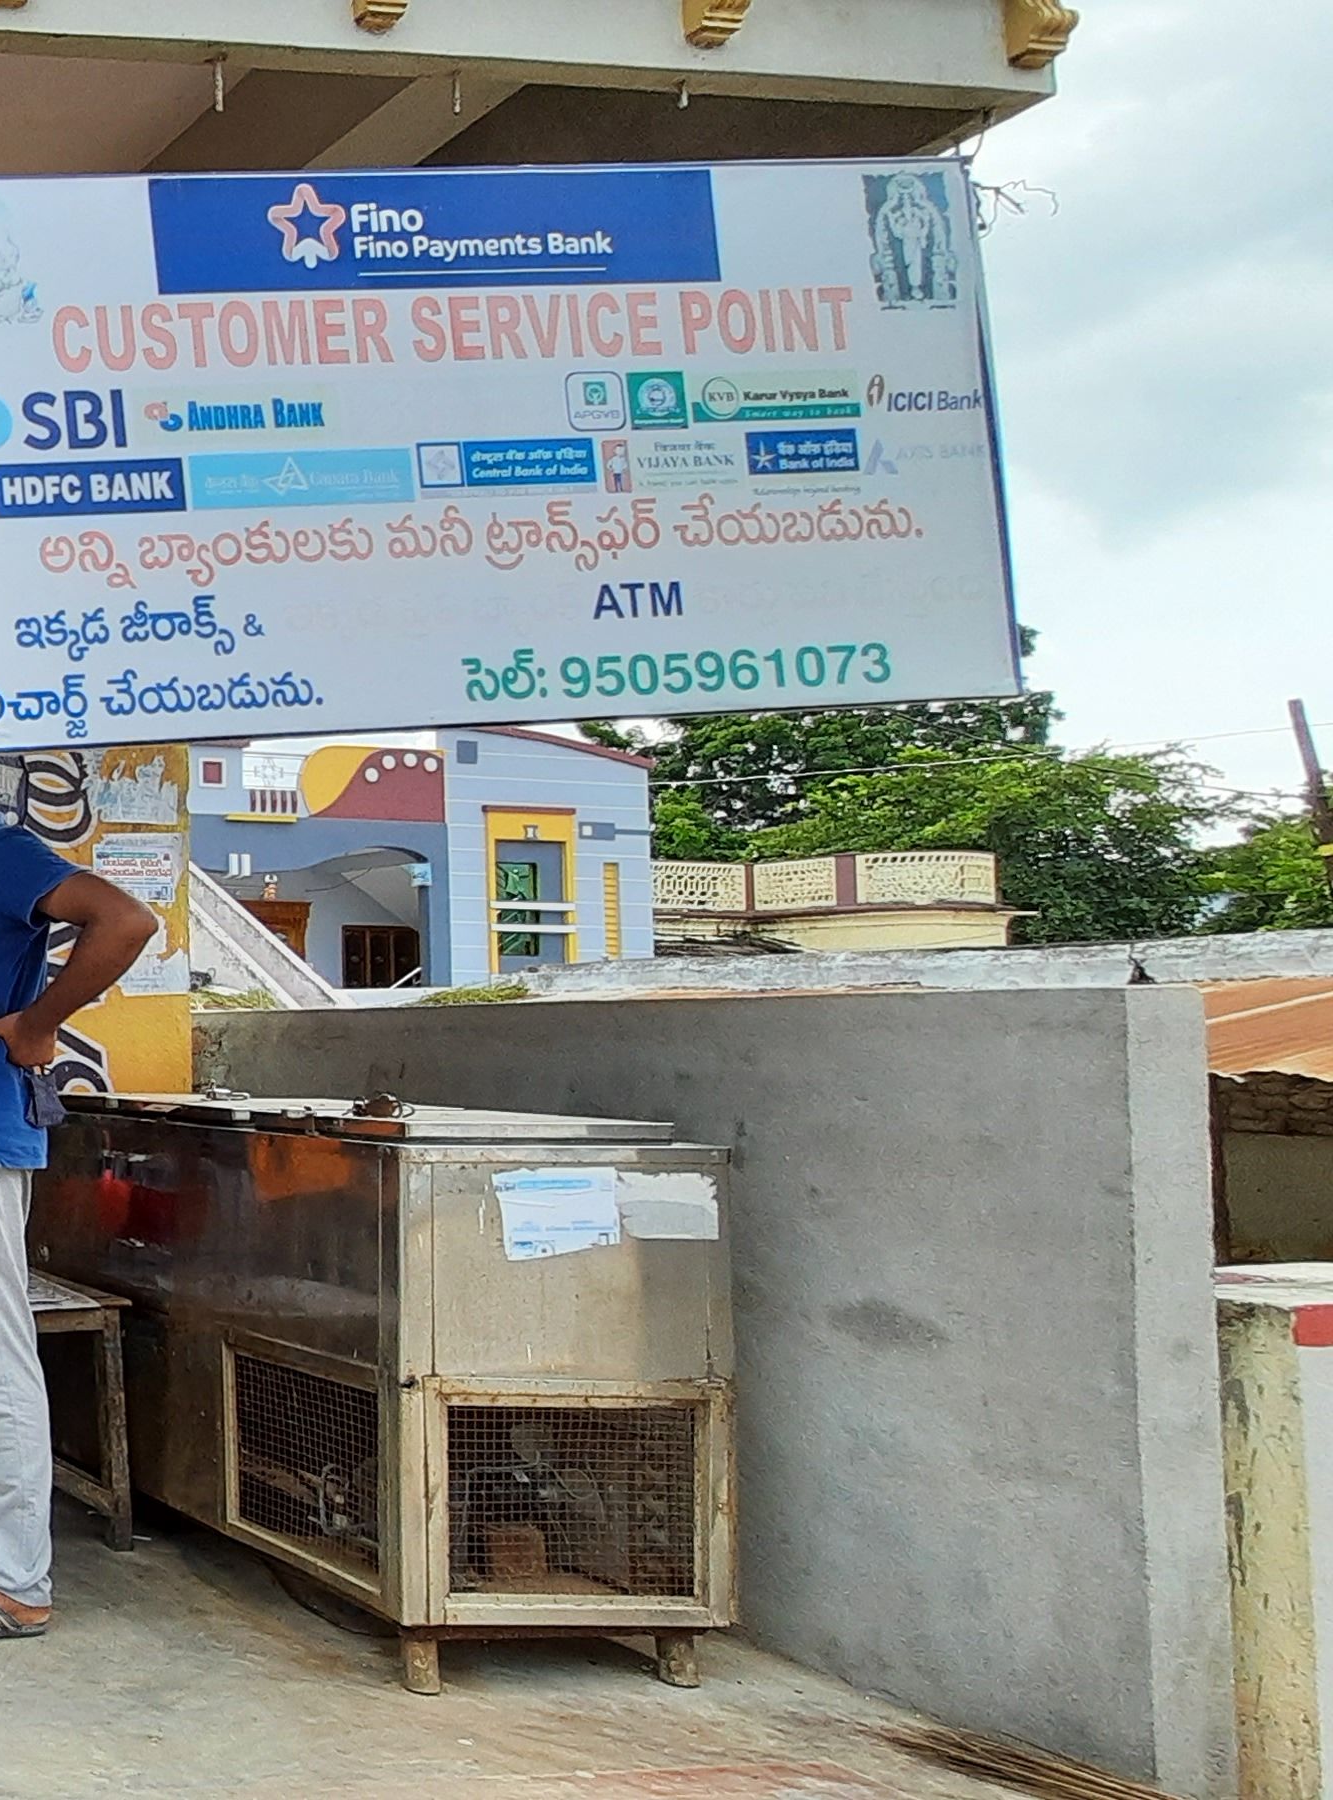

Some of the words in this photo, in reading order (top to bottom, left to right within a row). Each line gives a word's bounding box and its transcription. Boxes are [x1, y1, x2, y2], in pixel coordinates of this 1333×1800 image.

[350, 202, 423, 234] Fino
[354, 236, 409, 259] Fino
[413, 234, 542, 262] Payments
[547, 231, 613, 256] Bank
[52, 297, 395, 373] CUSTOMER
[411, 291, 661, 363] SERVICE
[679, 287, 853, 355] POINT
[707, 391, 735, 402] KVB
[743, 390, 776, 401] Karur
[779, 389, 816, 402] Vysya
[818, 388, 849, 399] Bank
[886, 391, 932, 412] ICICI
[936, 388, 984, 411] Bank
[21, 388, 128, 451] SBI
[188, 401, 266, 432] ANDHRA
[272, 398, 325, 428] BANK
[472, 465, 512, 478] Central
[514, 465, 543, 477] Bank
[545, 464, 557, 476] of
[559, 463, 588, 476] India
[637, 455, 689, 468] VIJAYA
[693, 453, 735, 467] BANK
[778, 458, 809, 470] Bank
[811, 457, 824, 469] of
[825, 457, 855, 469] India
[2, 475, 82, 507] HDFC
[88, 470, 175, 503] BANK
[39, 525, 135, 589] అన్ని
[138, 513, 373, 588] బ్యాంకులకు
[387, 512, 475, 558] మనీ
[671, 497, 924, 552] చేయబడును.
[593, 580, 684, 620] ATM
[15, 607, 110, 662] ఇక్కడ
[120, 595, 235, 655] జీరాక్స్
[243, 613, 265, 637] &
[461, 648, 548, 702] సెల్:
[559, 642, 892, 699] 9505961073
[99, 668, 323, 717] చేయబడును.
